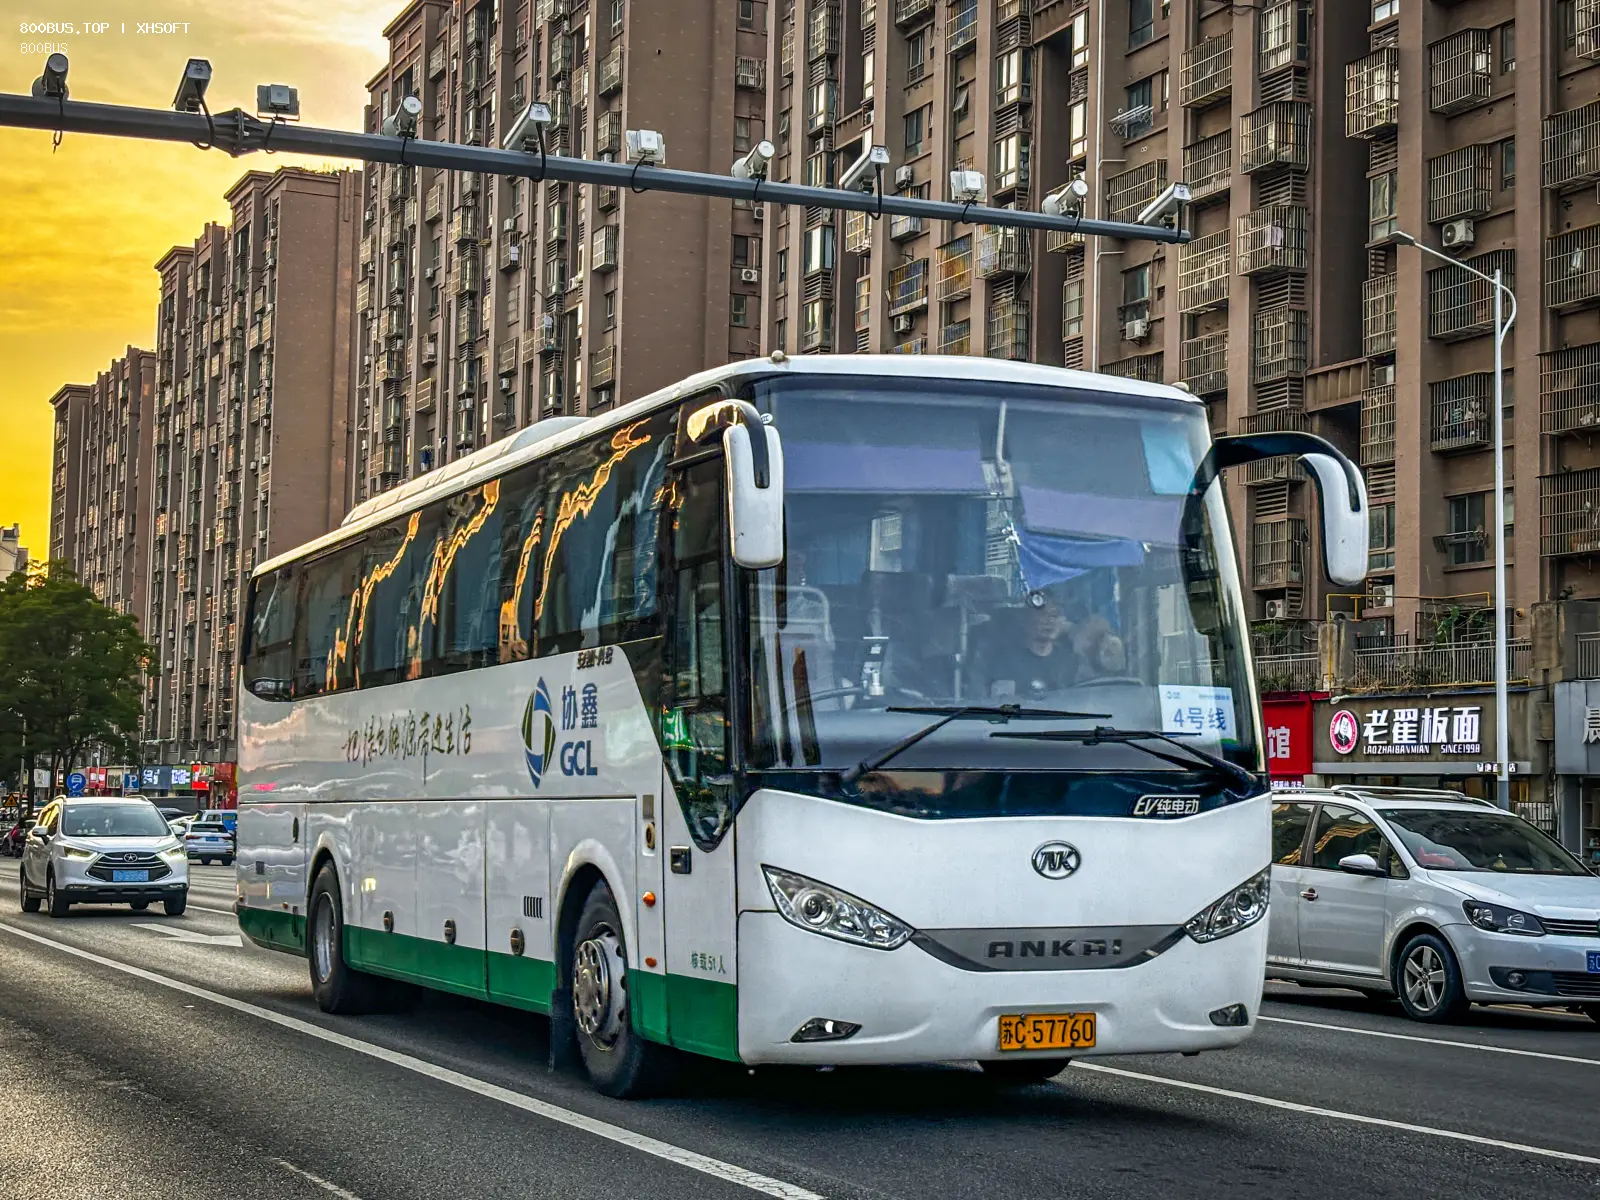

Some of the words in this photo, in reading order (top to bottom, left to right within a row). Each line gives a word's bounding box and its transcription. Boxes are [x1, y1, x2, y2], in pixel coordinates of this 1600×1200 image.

[562, 683, 598, 730] 协鑫
[1173, 707, 1226, 730] 4号线
[1363, 706, 1482, 745] 老翟板面
[560, 740, 598, 777] GCL
[1363, 745, 1430, 755] LAOZHAIBANMIAN
[1440, 743, 1481, 754] SINCE1998
[128, 775, 138, 788] P
[1133, 794, 1200, 815] EV纯电动
[988, 940, 1122, 958] ANKAI
